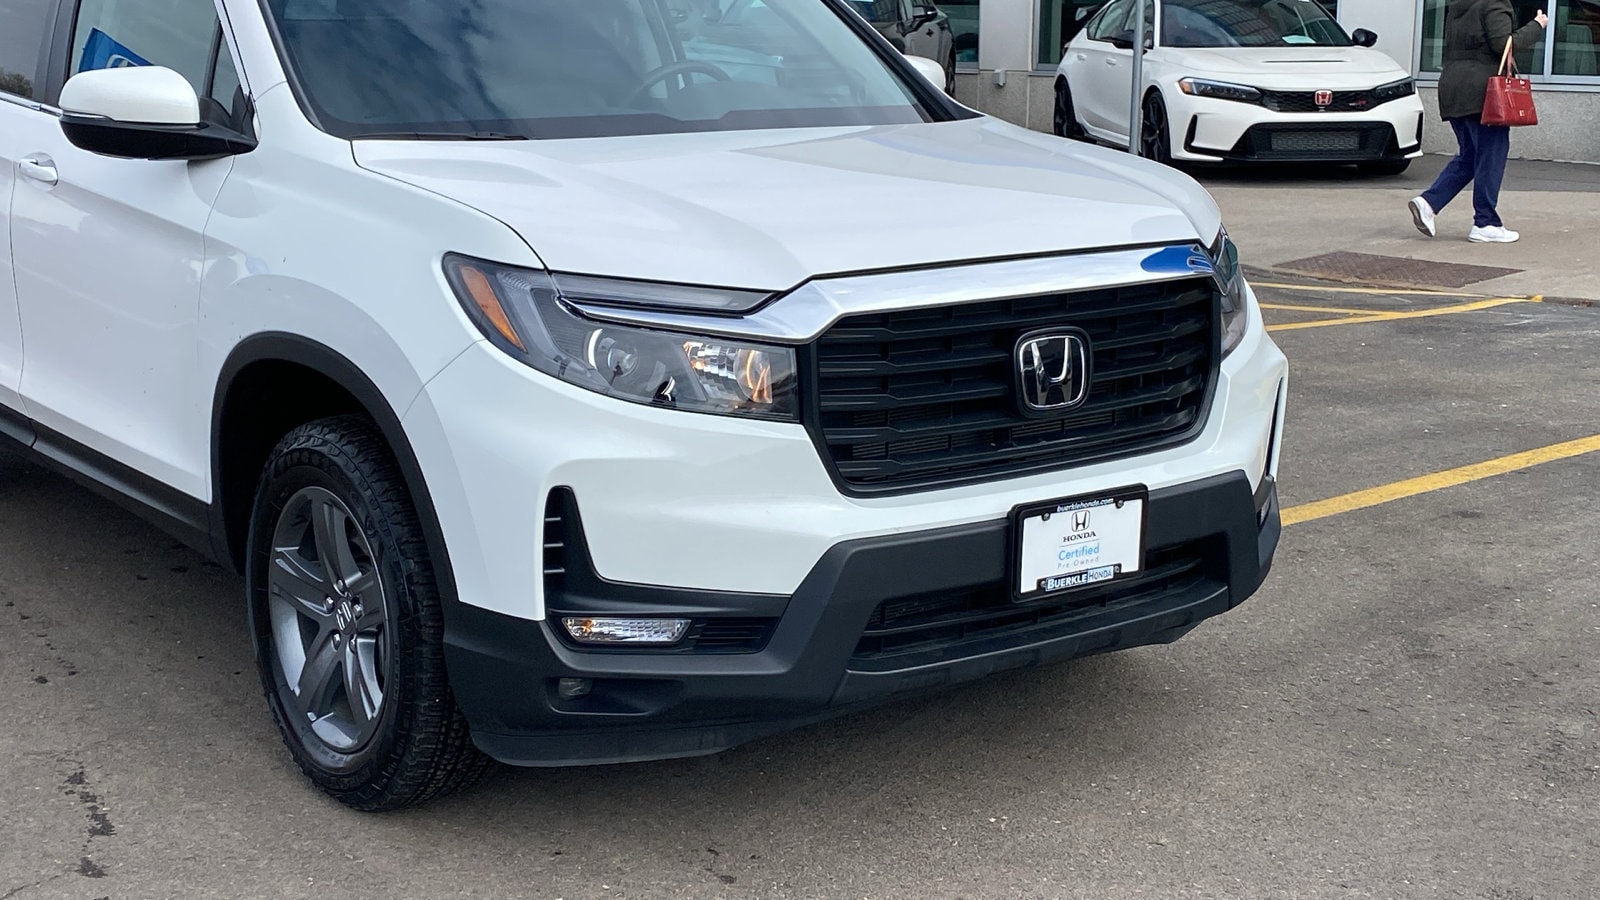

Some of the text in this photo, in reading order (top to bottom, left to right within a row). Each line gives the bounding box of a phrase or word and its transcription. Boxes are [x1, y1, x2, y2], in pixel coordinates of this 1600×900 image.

[1063, 531, 1097, 542] HONDA
[1058, 543, 1100, 561] Certified
[1047, 569, 1112, 590] BUERKLE HONDA
